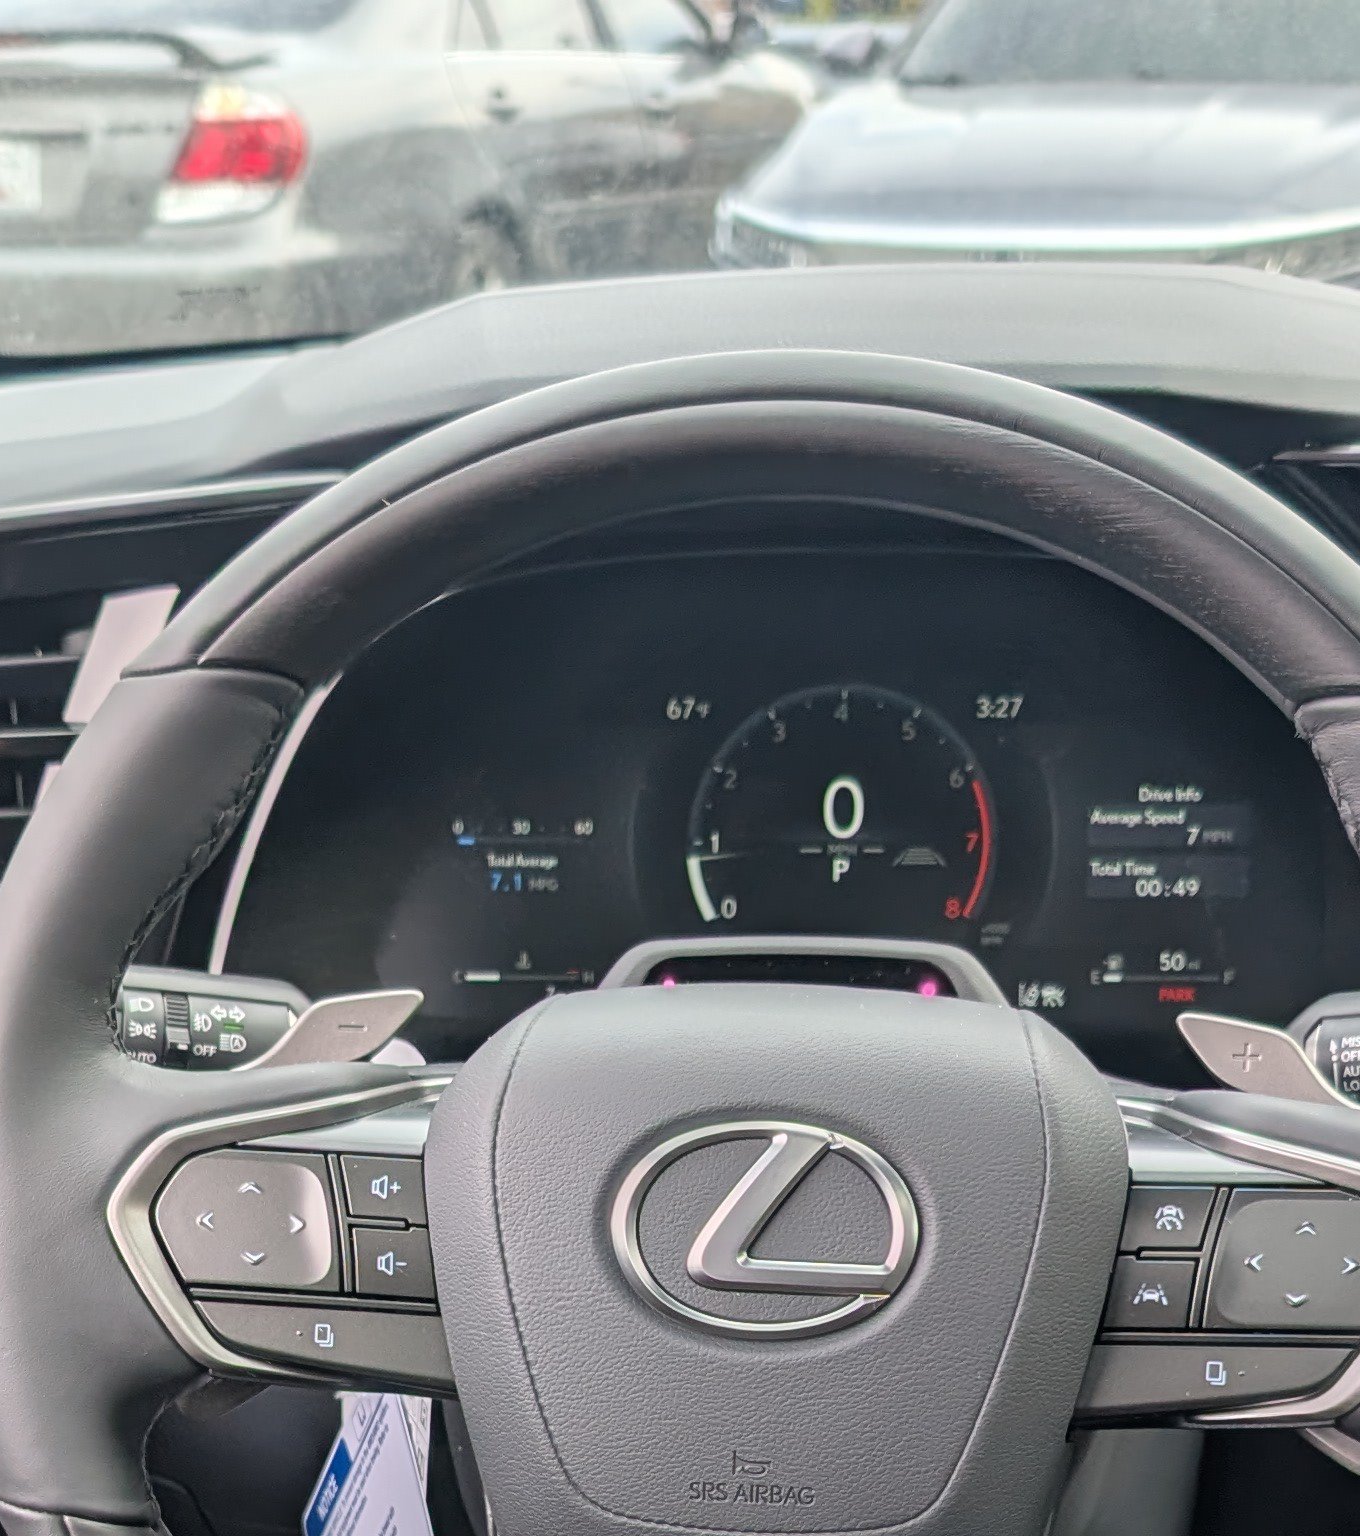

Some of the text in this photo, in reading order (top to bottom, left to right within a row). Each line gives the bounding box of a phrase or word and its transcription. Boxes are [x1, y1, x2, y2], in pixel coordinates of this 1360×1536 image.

[976, 695, 1024, 719] 3:27
[773, 721, 787, 743] 3
[901, 720, 916, 741] 5
[725, 769, 737, 789] 2
[949, 769, 964, 788] 6
[1138, 784, 1203, 803] Drive Info
[823, 776, 865, 839] 0
[1090, 806, 1186, 828] Average Speed
[452, 819, 464, 835] 0
[1186, 825, 1201, 846] 7
[711, 831, 720, 853] 1
[966, 832, 979, 852] 7
[832, 857, 851, 883] P
[1090, 857, 1157, 877] Total Time
[490, 870, 522, 892] 7.1
[1135, 876, 1201, 898] 00:49
[720, 898, 737, 919] 0
[945, 897, 960, 919] 8
[1159, 951, 1186, 972] 50
[1158, 986, 1196, 1002] PARK
[193, 1043, 218, 1057] OFF
[1343, 1080, 1360, 1092] LO
[688, 1481, 729, 1501] SRS
[732, 1483, 816, 1506] AIRBAG
